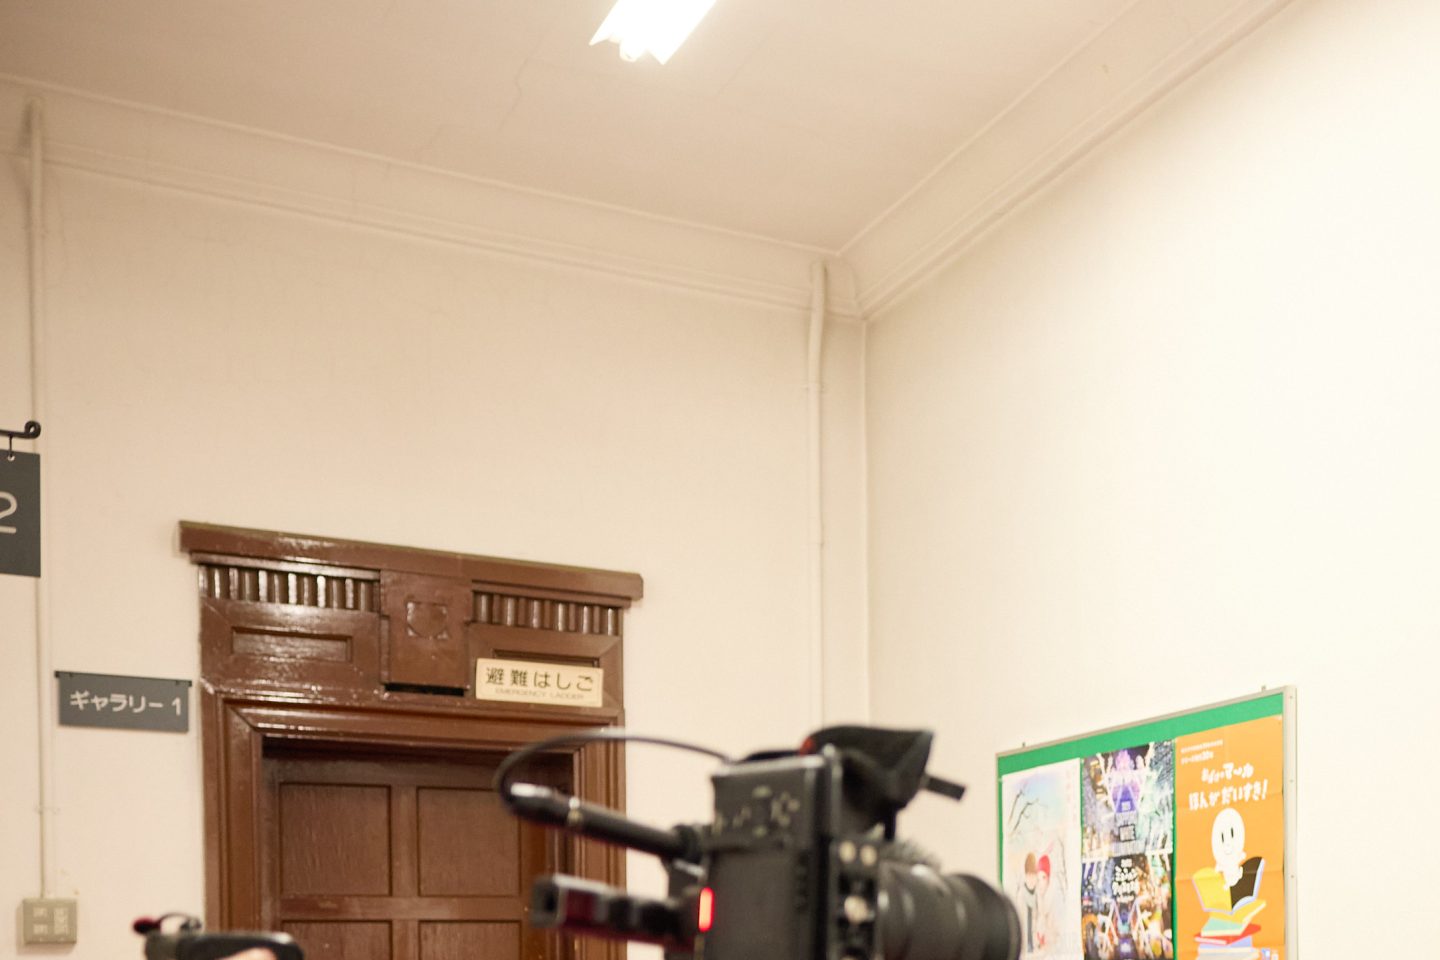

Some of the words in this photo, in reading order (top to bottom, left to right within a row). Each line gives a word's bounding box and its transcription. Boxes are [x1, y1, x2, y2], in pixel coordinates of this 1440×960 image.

[486, 667, 594, 692] 避難はしご
[495, 687, 546, 697] EMERGENCY
[70, 690, 163, 714] ギャラリー
[171, 697, 181, 716] 1
